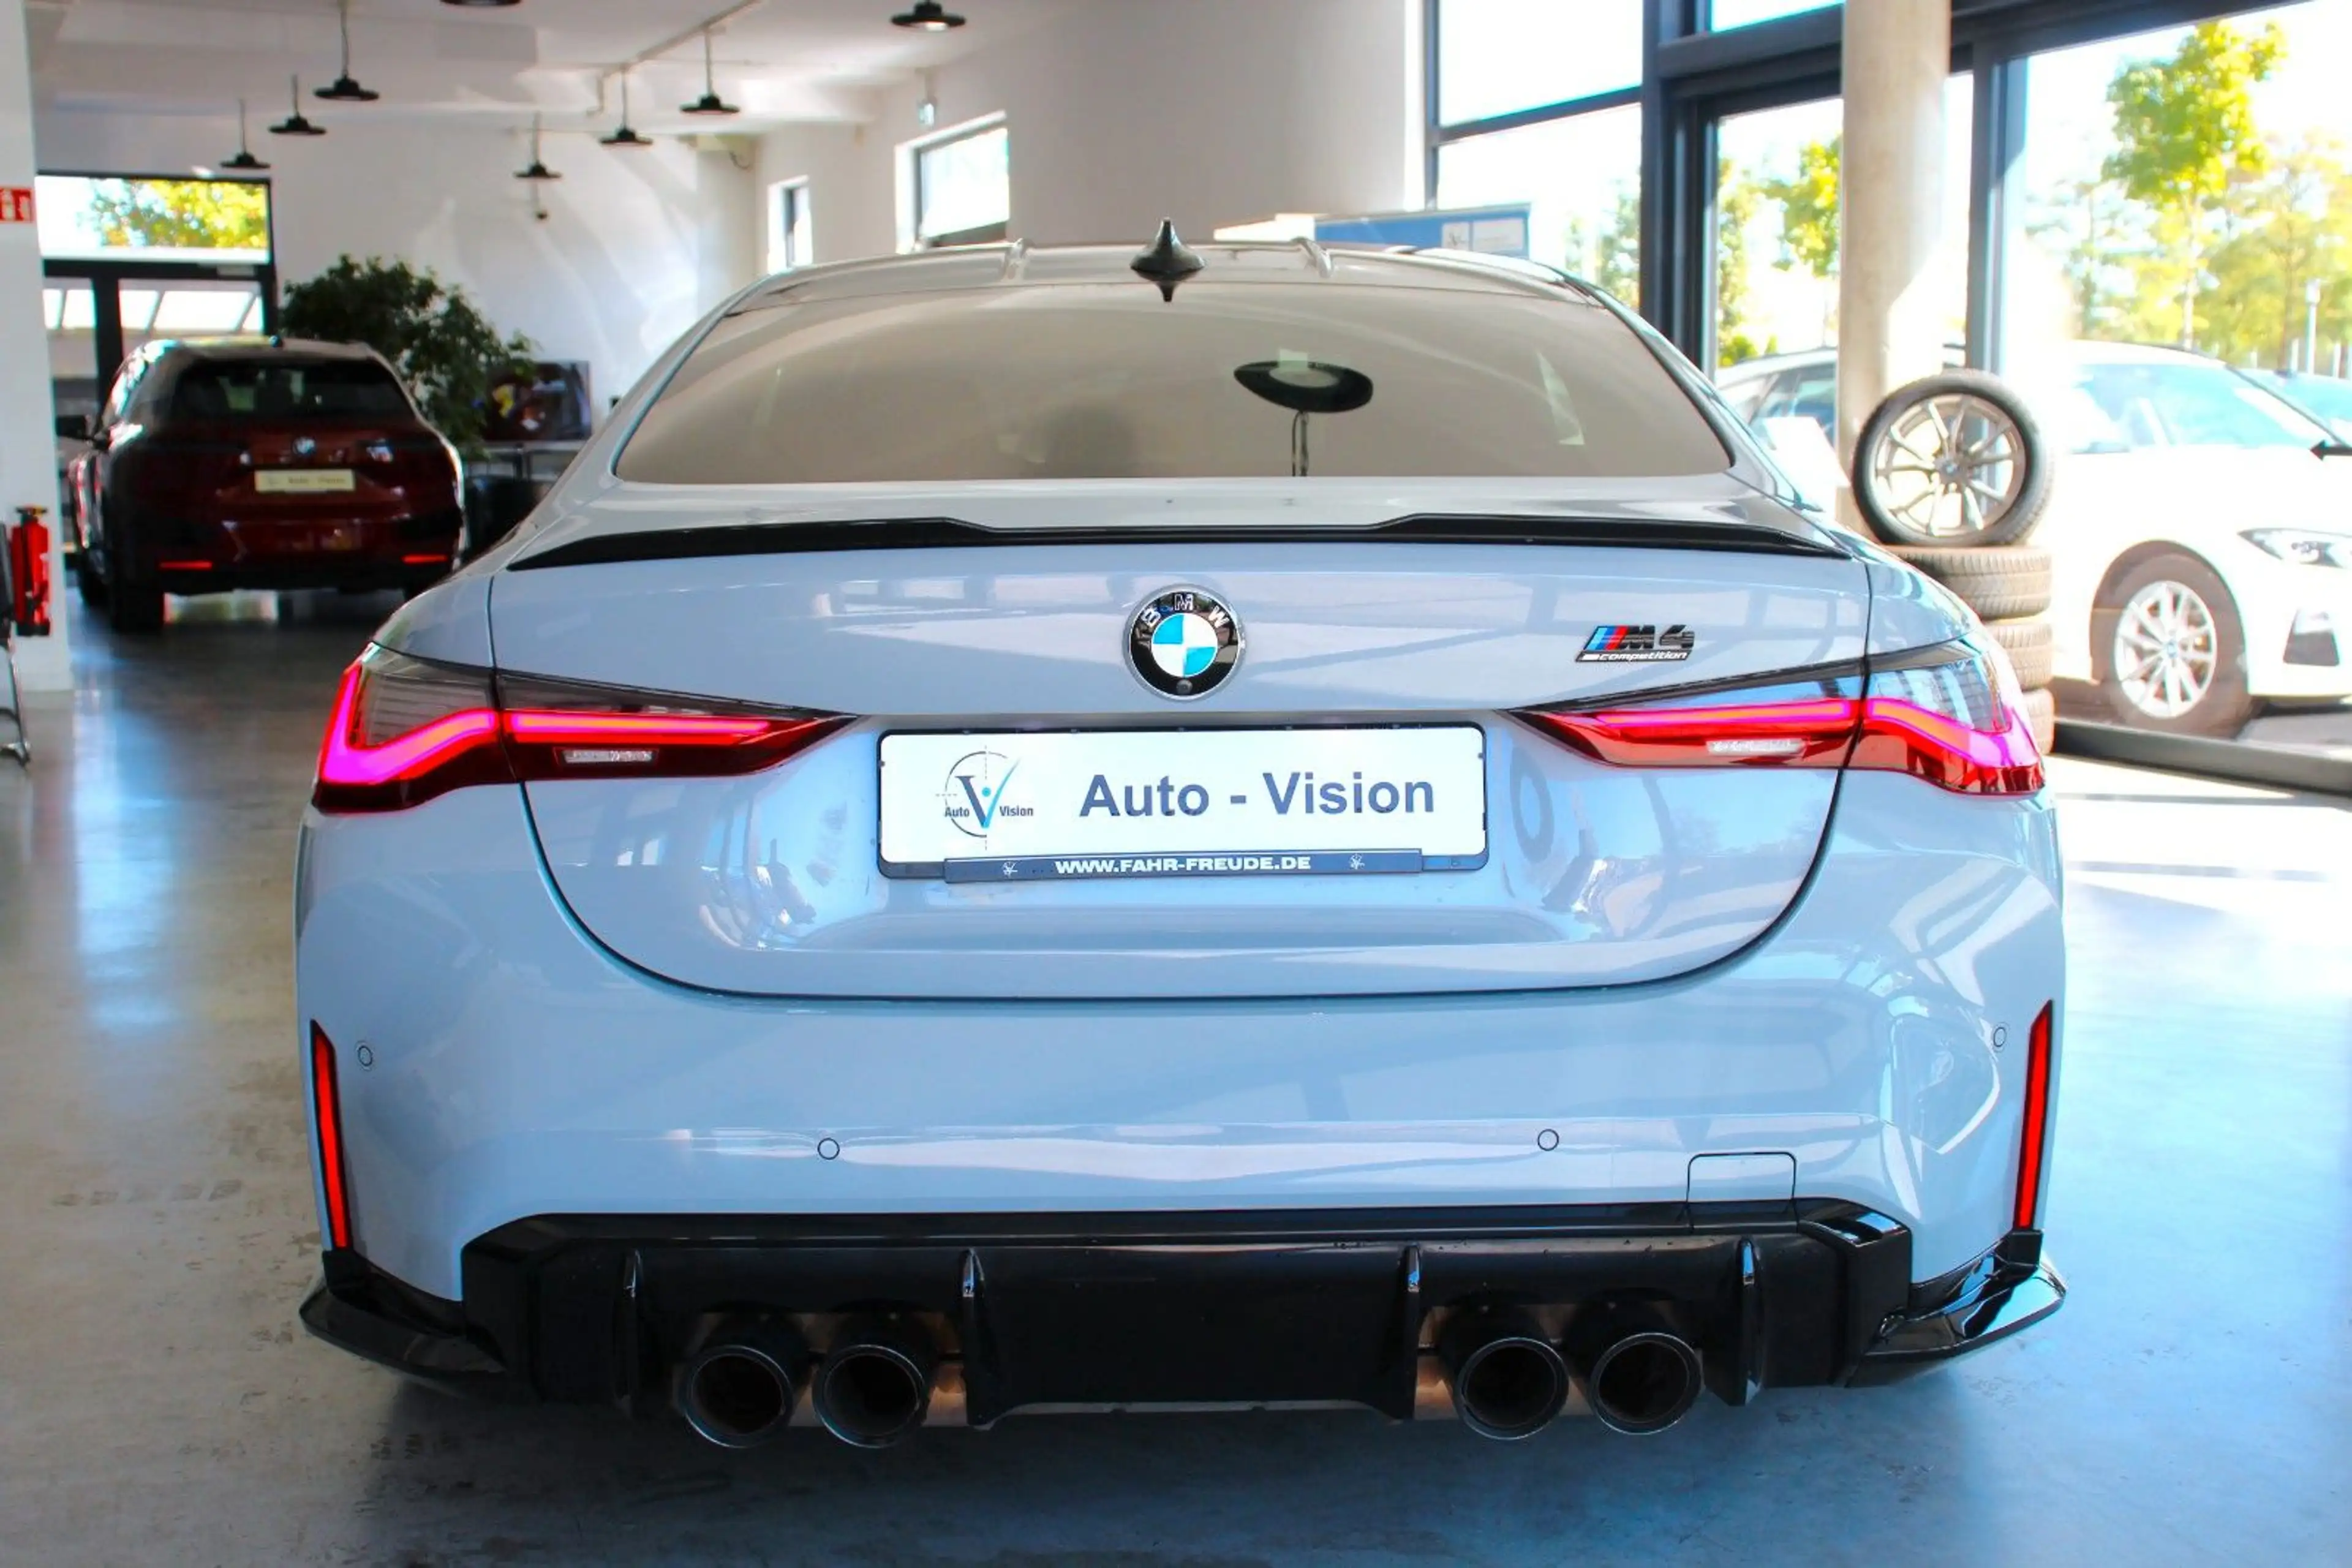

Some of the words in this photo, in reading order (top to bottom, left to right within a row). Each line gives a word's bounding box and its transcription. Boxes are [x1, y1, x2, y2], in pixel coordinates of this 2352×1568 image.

[1141, 594, 1229, 628] BMW
[1619, 624, 1695, 650] M4
[1599, 651, 1687, 660] competition
[1079, 774, 1210, 817] Auto
[1230, 795, 1247, 804] -
[1262, 771, 1434, 815] Vision
[944, 806, 970, 818] Auto
[1000, 805, 1035, 817] Vision
[1055, 857, 1311, 874] WWW.FAHR-FREUDE.DE
